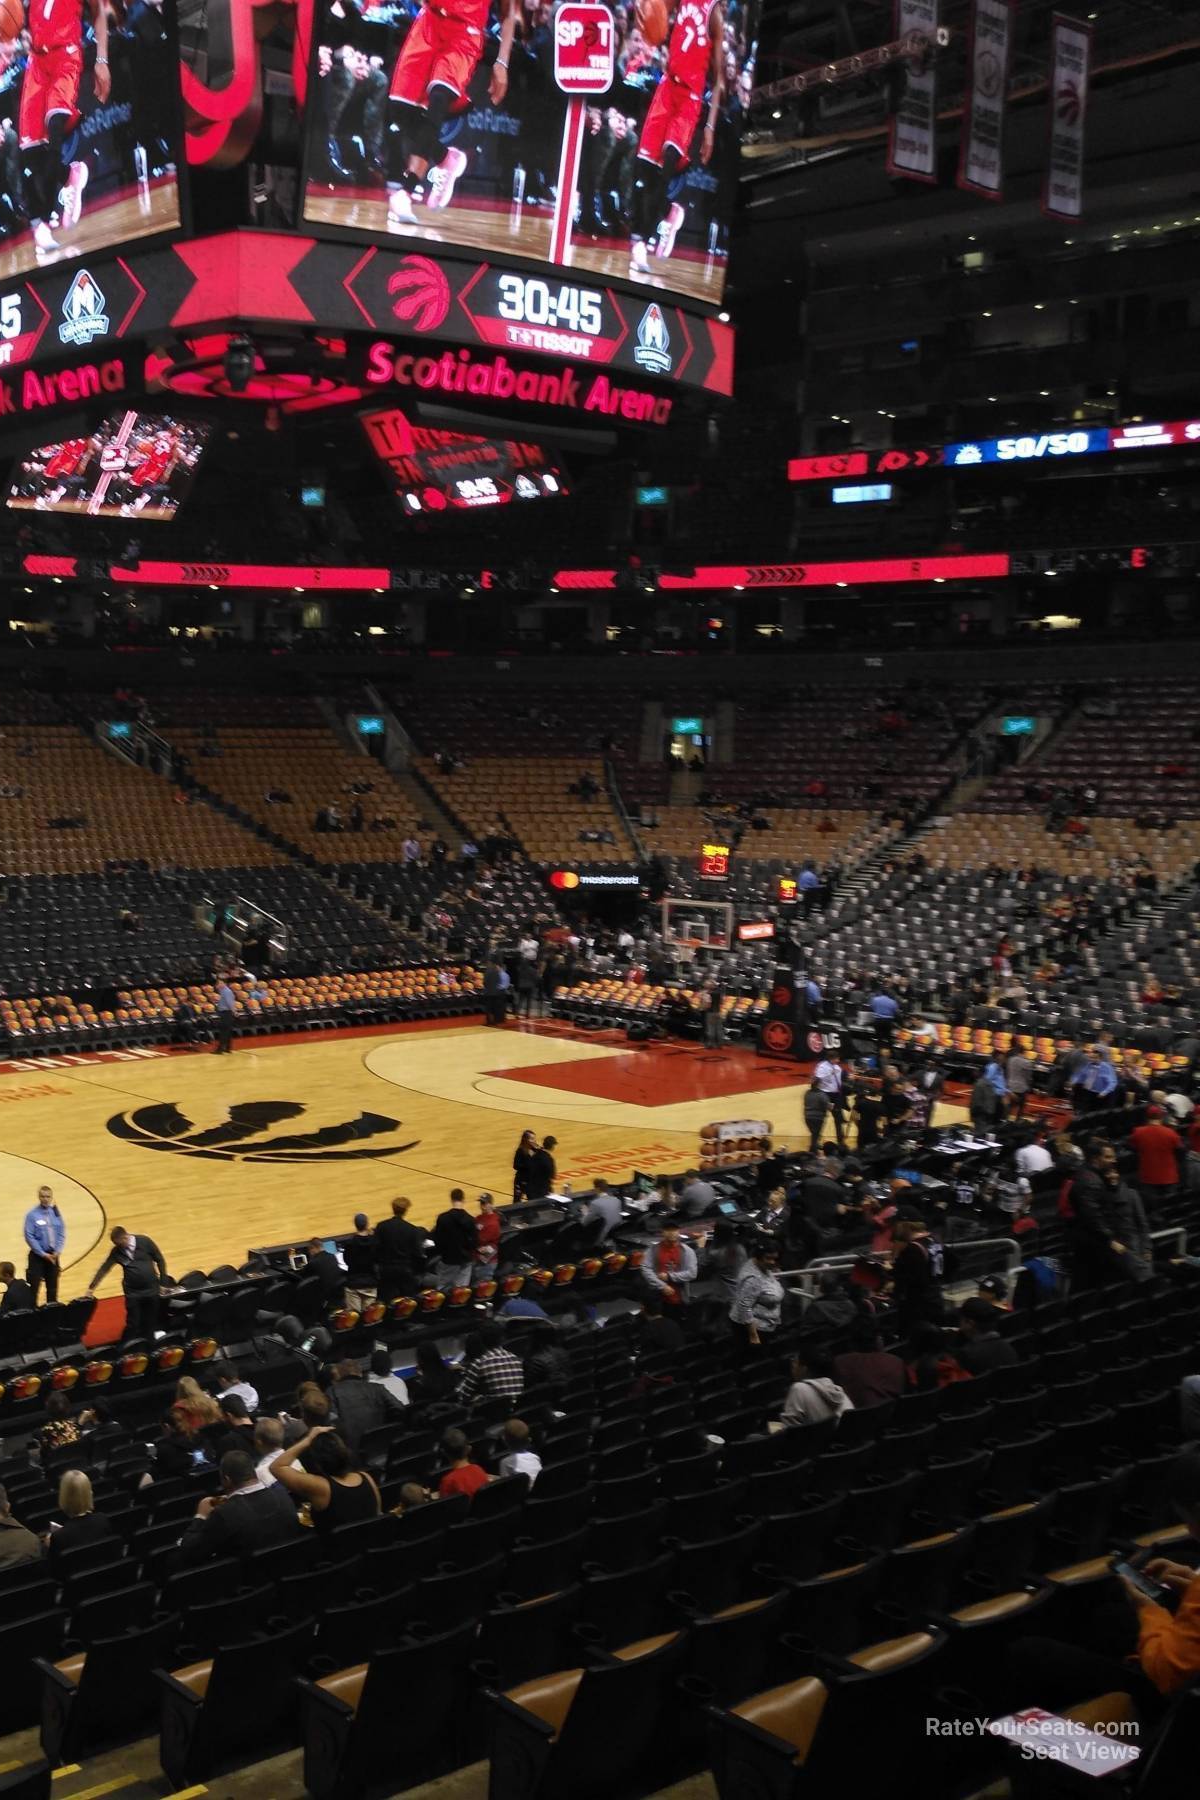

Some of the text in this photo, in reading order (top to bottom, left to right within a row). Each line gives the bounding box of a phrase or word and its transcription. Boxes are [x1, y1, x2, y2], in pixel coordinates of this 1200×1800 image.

[498, 274, 602, 335] 30:45
[533, 327, 593, 357] TISSOT
[22, 359, 126, 410] Arena
[366, 341, 673, 425] Scotiabank Arena
[997, 432, 1089, 460] 50/50
[704, 856, 726, 875] 23
[580, 875, 639, 885] mastercard
[96, 1047, 170, 1062] WE
[569, 1143, 674, 1165] Arena
